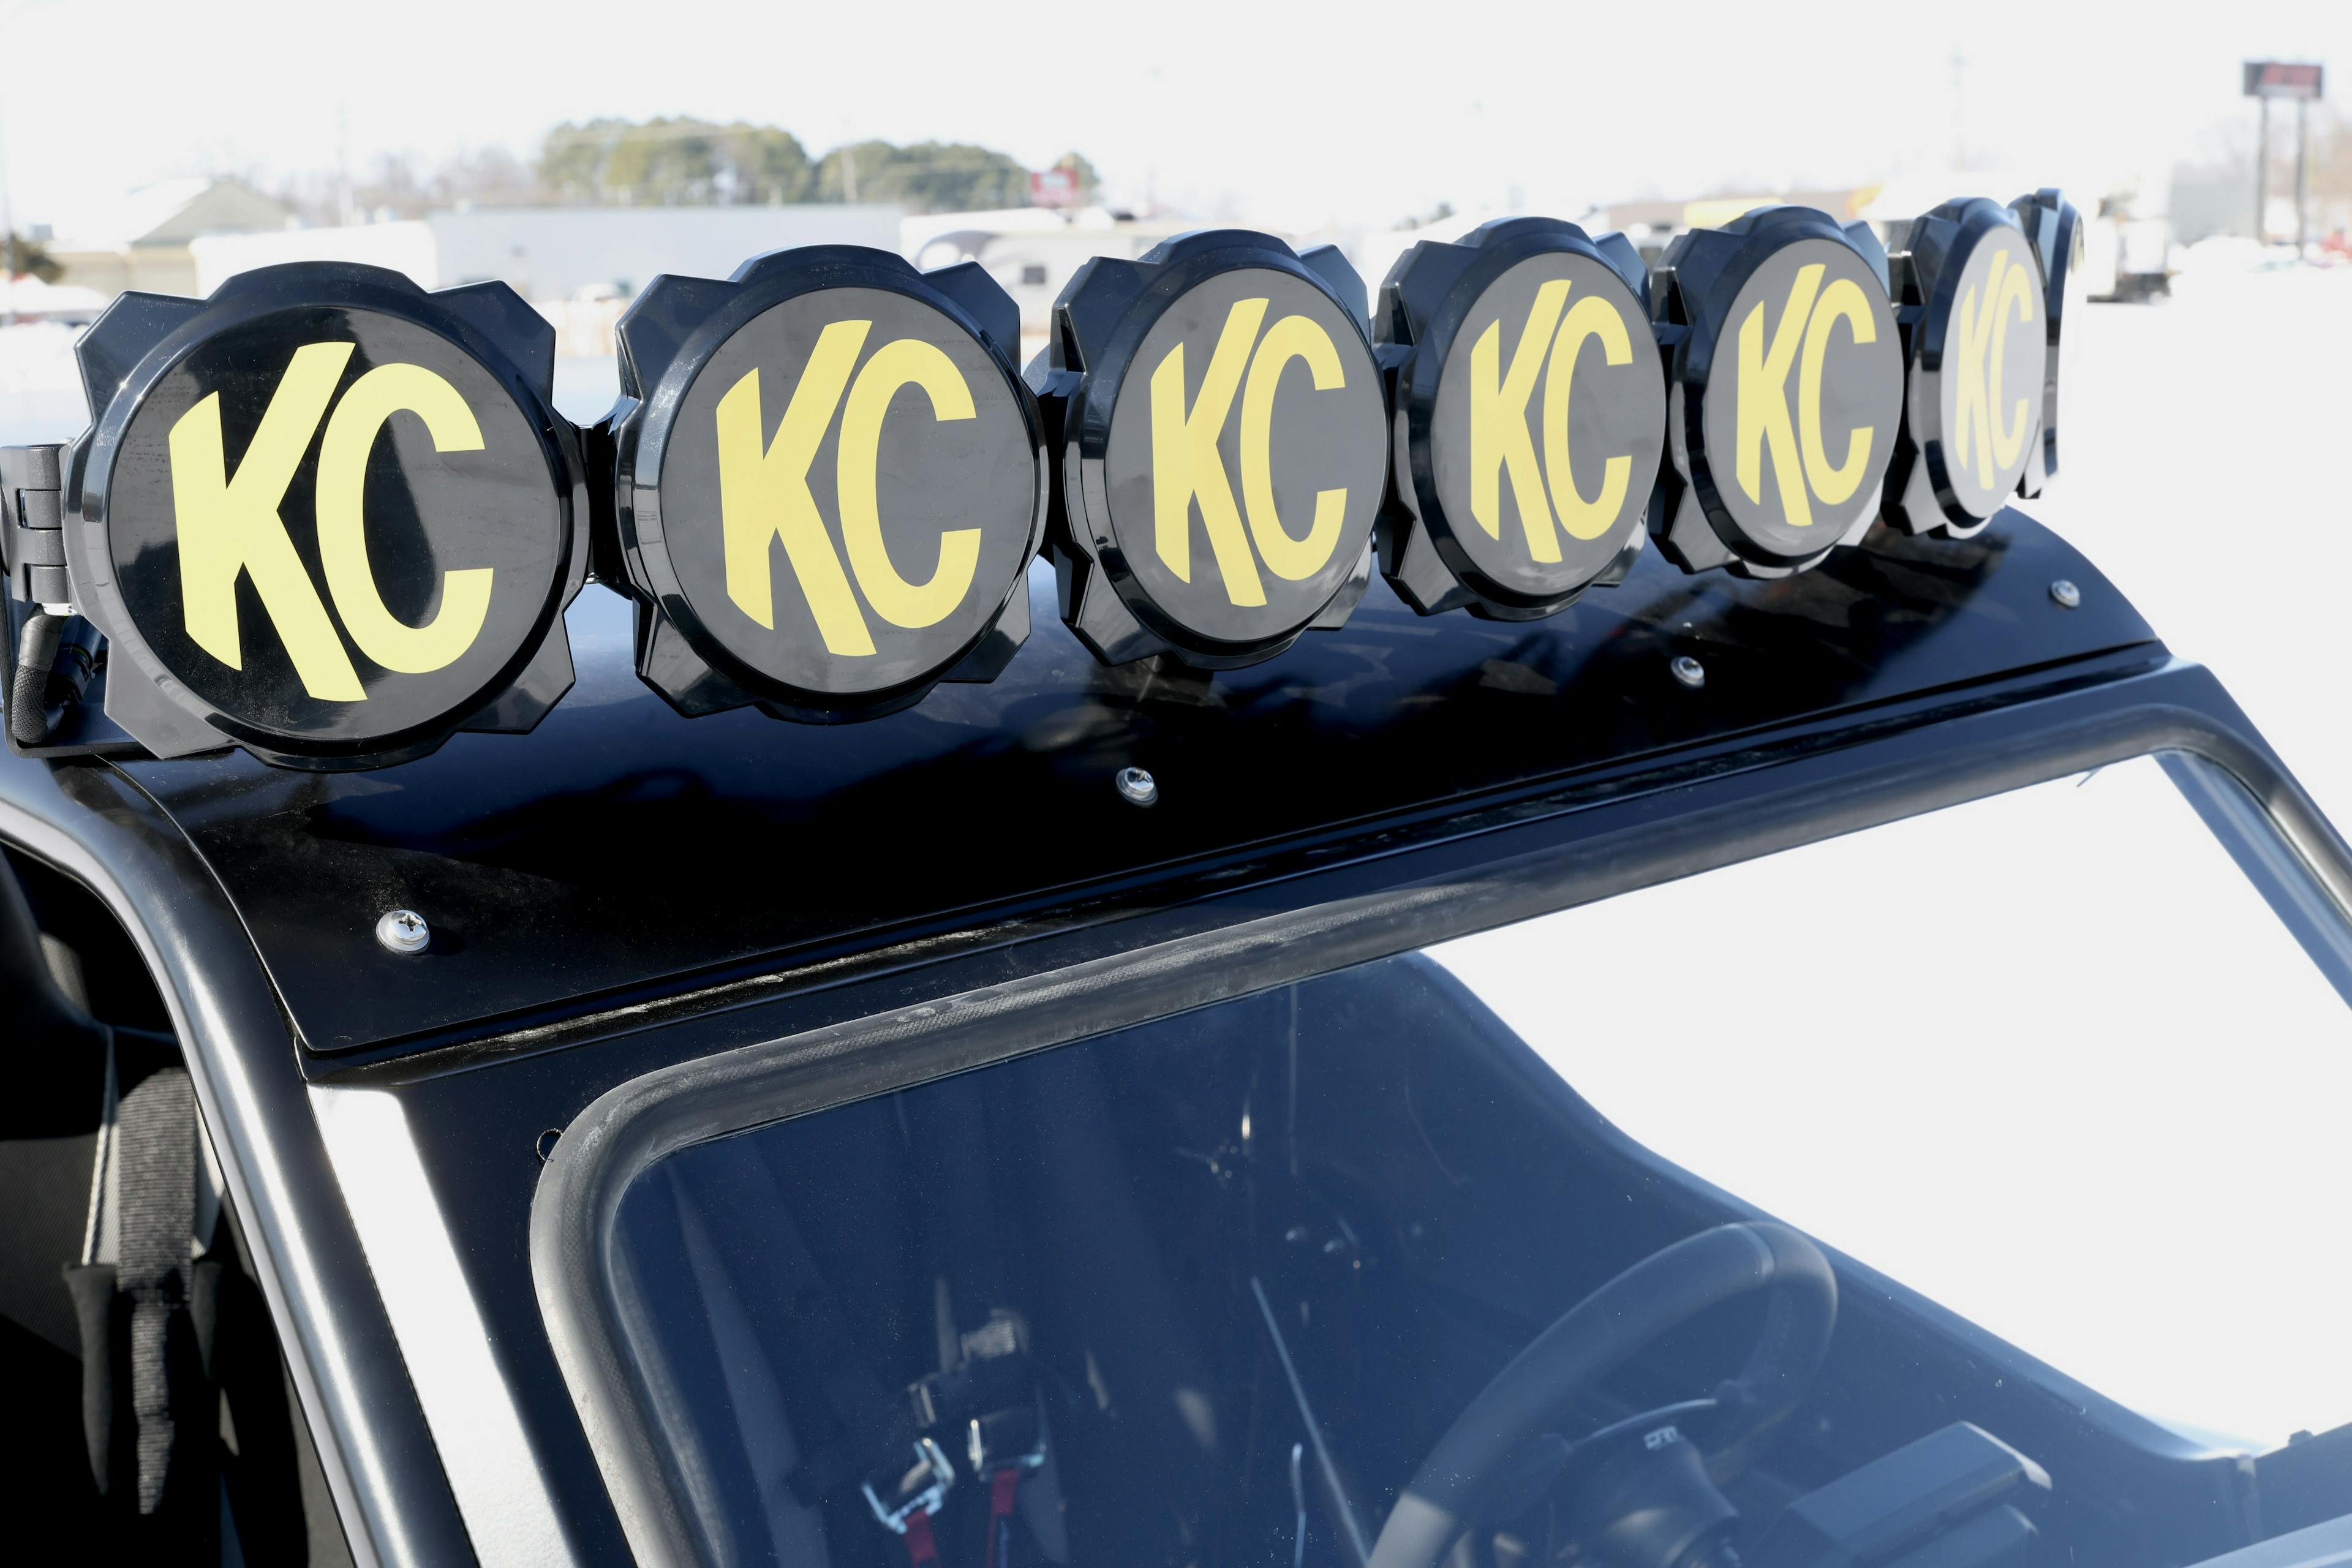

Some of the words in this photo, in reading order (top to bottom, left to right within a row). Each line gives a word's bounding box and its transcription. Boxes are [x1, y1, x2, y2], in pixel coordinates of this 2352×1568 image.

[717, 320, 981, 657] KC
[1151, 298, 1347, 607] KC
[1471, 279, 1634, 563] KC
[1737, 264, 1877, 526] KC
[1955, 249, 2034, 490] KC
[168, 342, 494, 701] KC
